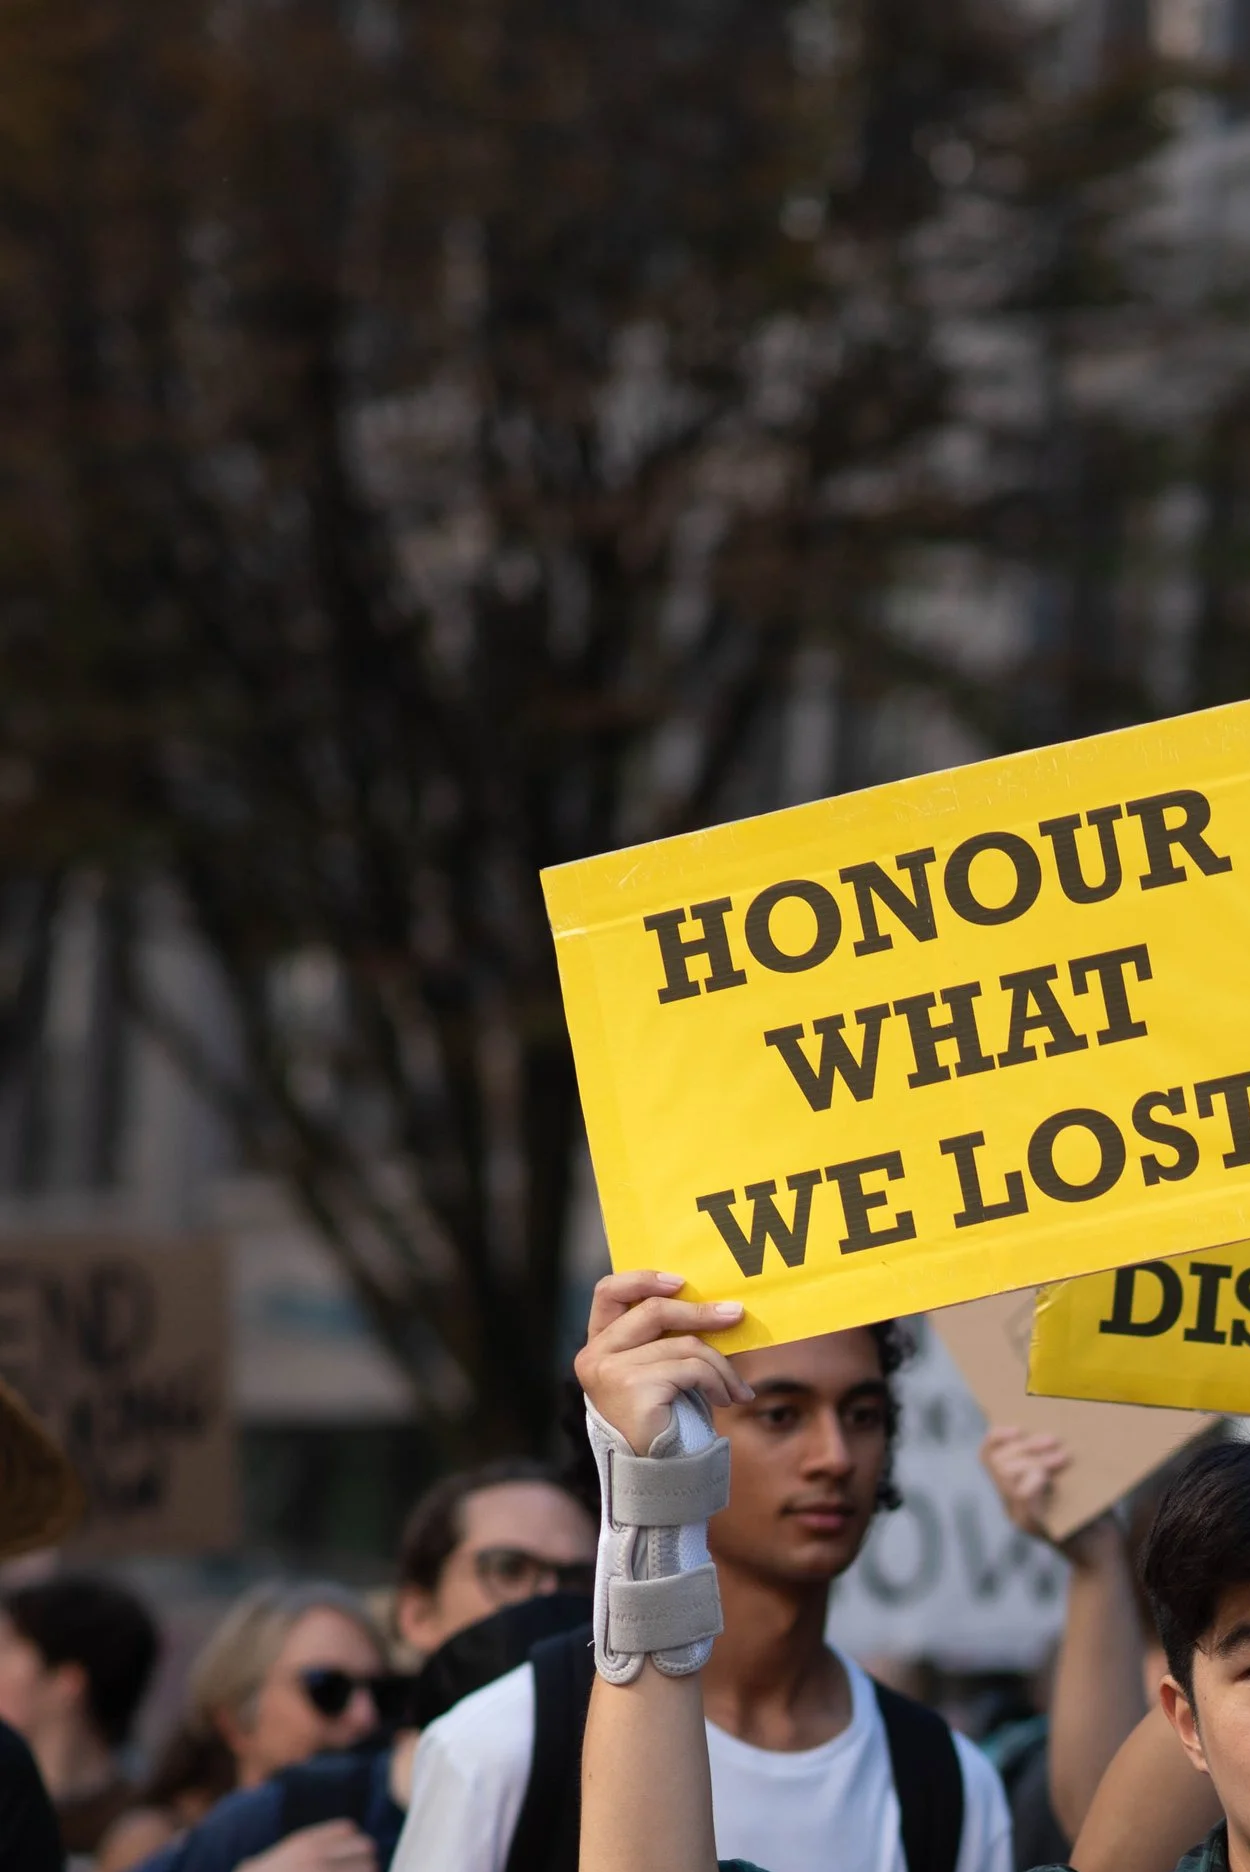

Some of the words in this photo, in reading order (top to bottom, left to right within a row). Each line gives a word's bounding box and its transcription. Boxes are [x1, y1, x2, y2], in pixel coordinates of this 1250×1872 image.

[643, 789, 1232, 1004] HONOUR
[764, 943, 1153, 1112] WHAT
[696, 1150, 917, 1277] WE
